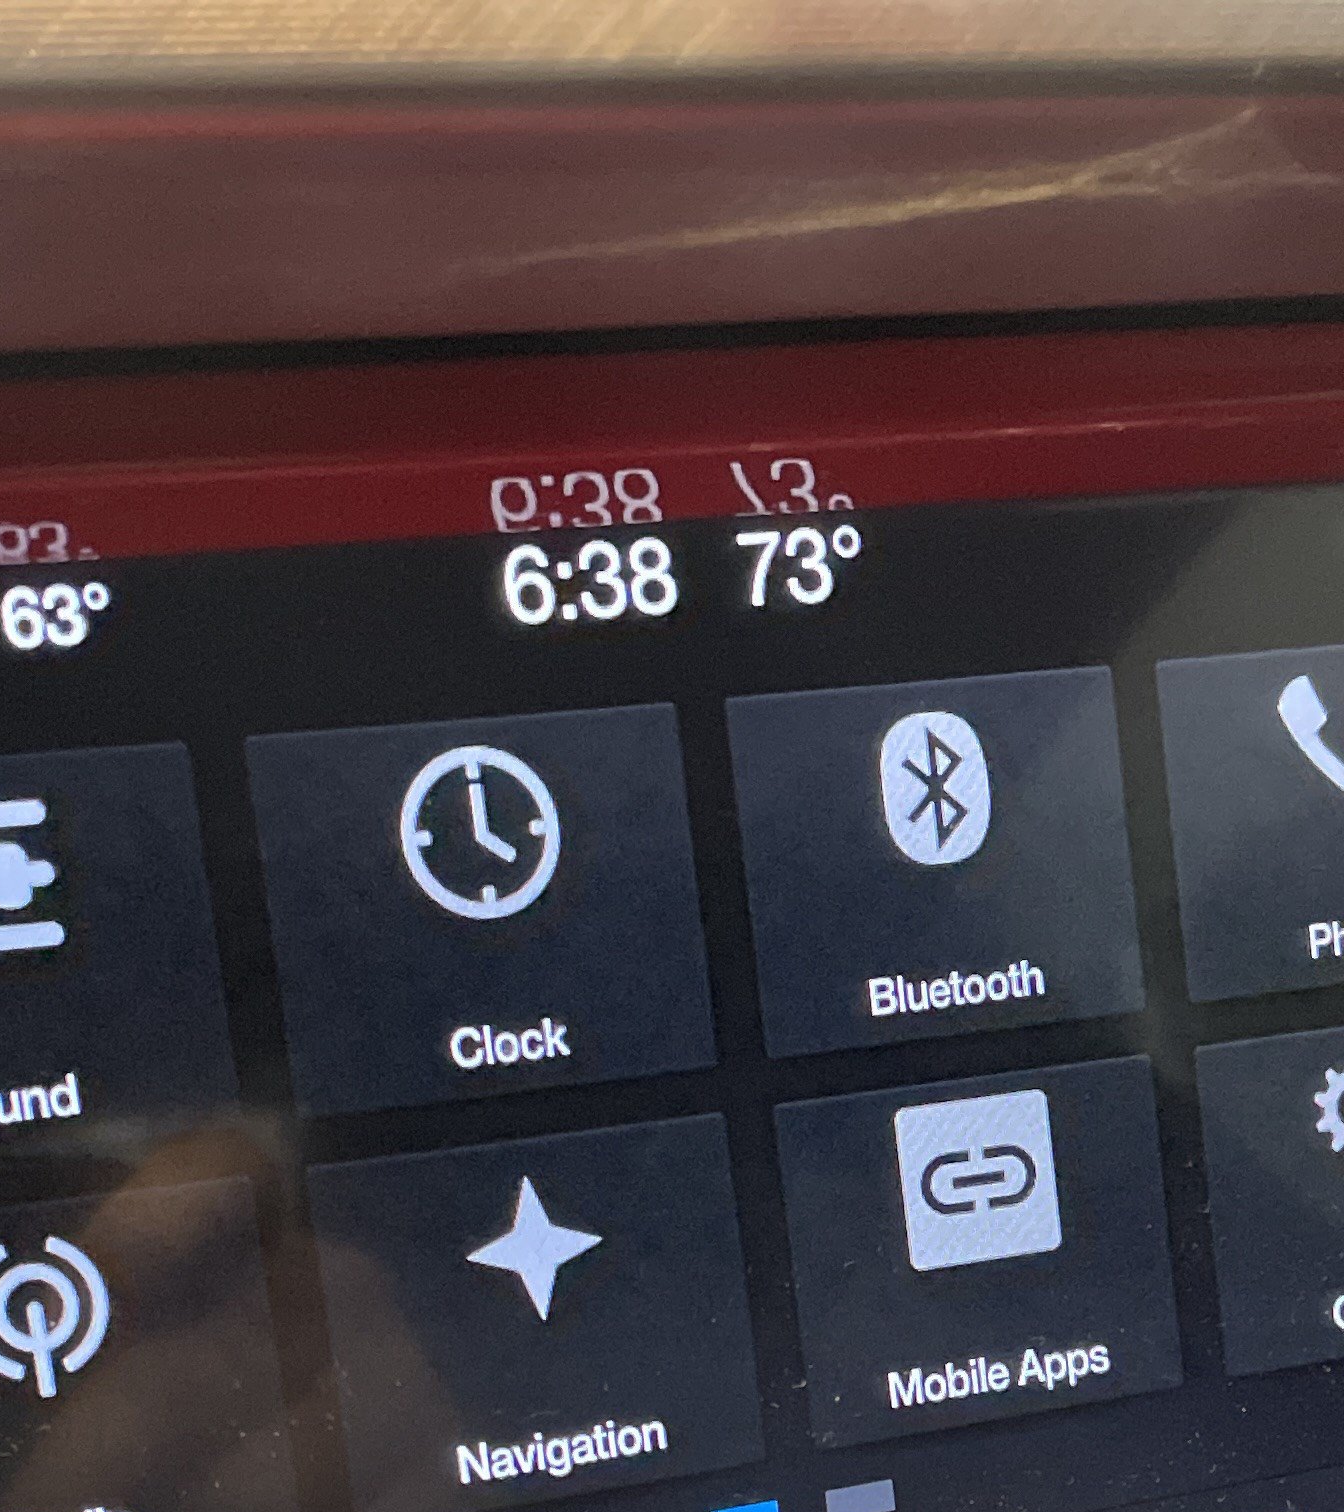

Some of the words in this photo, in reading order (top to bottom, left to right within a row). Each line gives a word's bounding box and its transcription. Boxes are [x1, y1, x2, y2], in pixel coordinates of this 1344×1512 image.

[504, 537, 677, 625] 6:38
[736, 525, 861, 606] 73°
[0, 583, 109, 650] 63°
[869, 960, 1045, 1016] Bluetooth
[450, 1018, 570, 1069] Clock
[888, 1357, 1010, 1408] Mobile
[1018, 1345, 1110, 1390] Apps
[456, 1421, 667, 1484] Navigation
